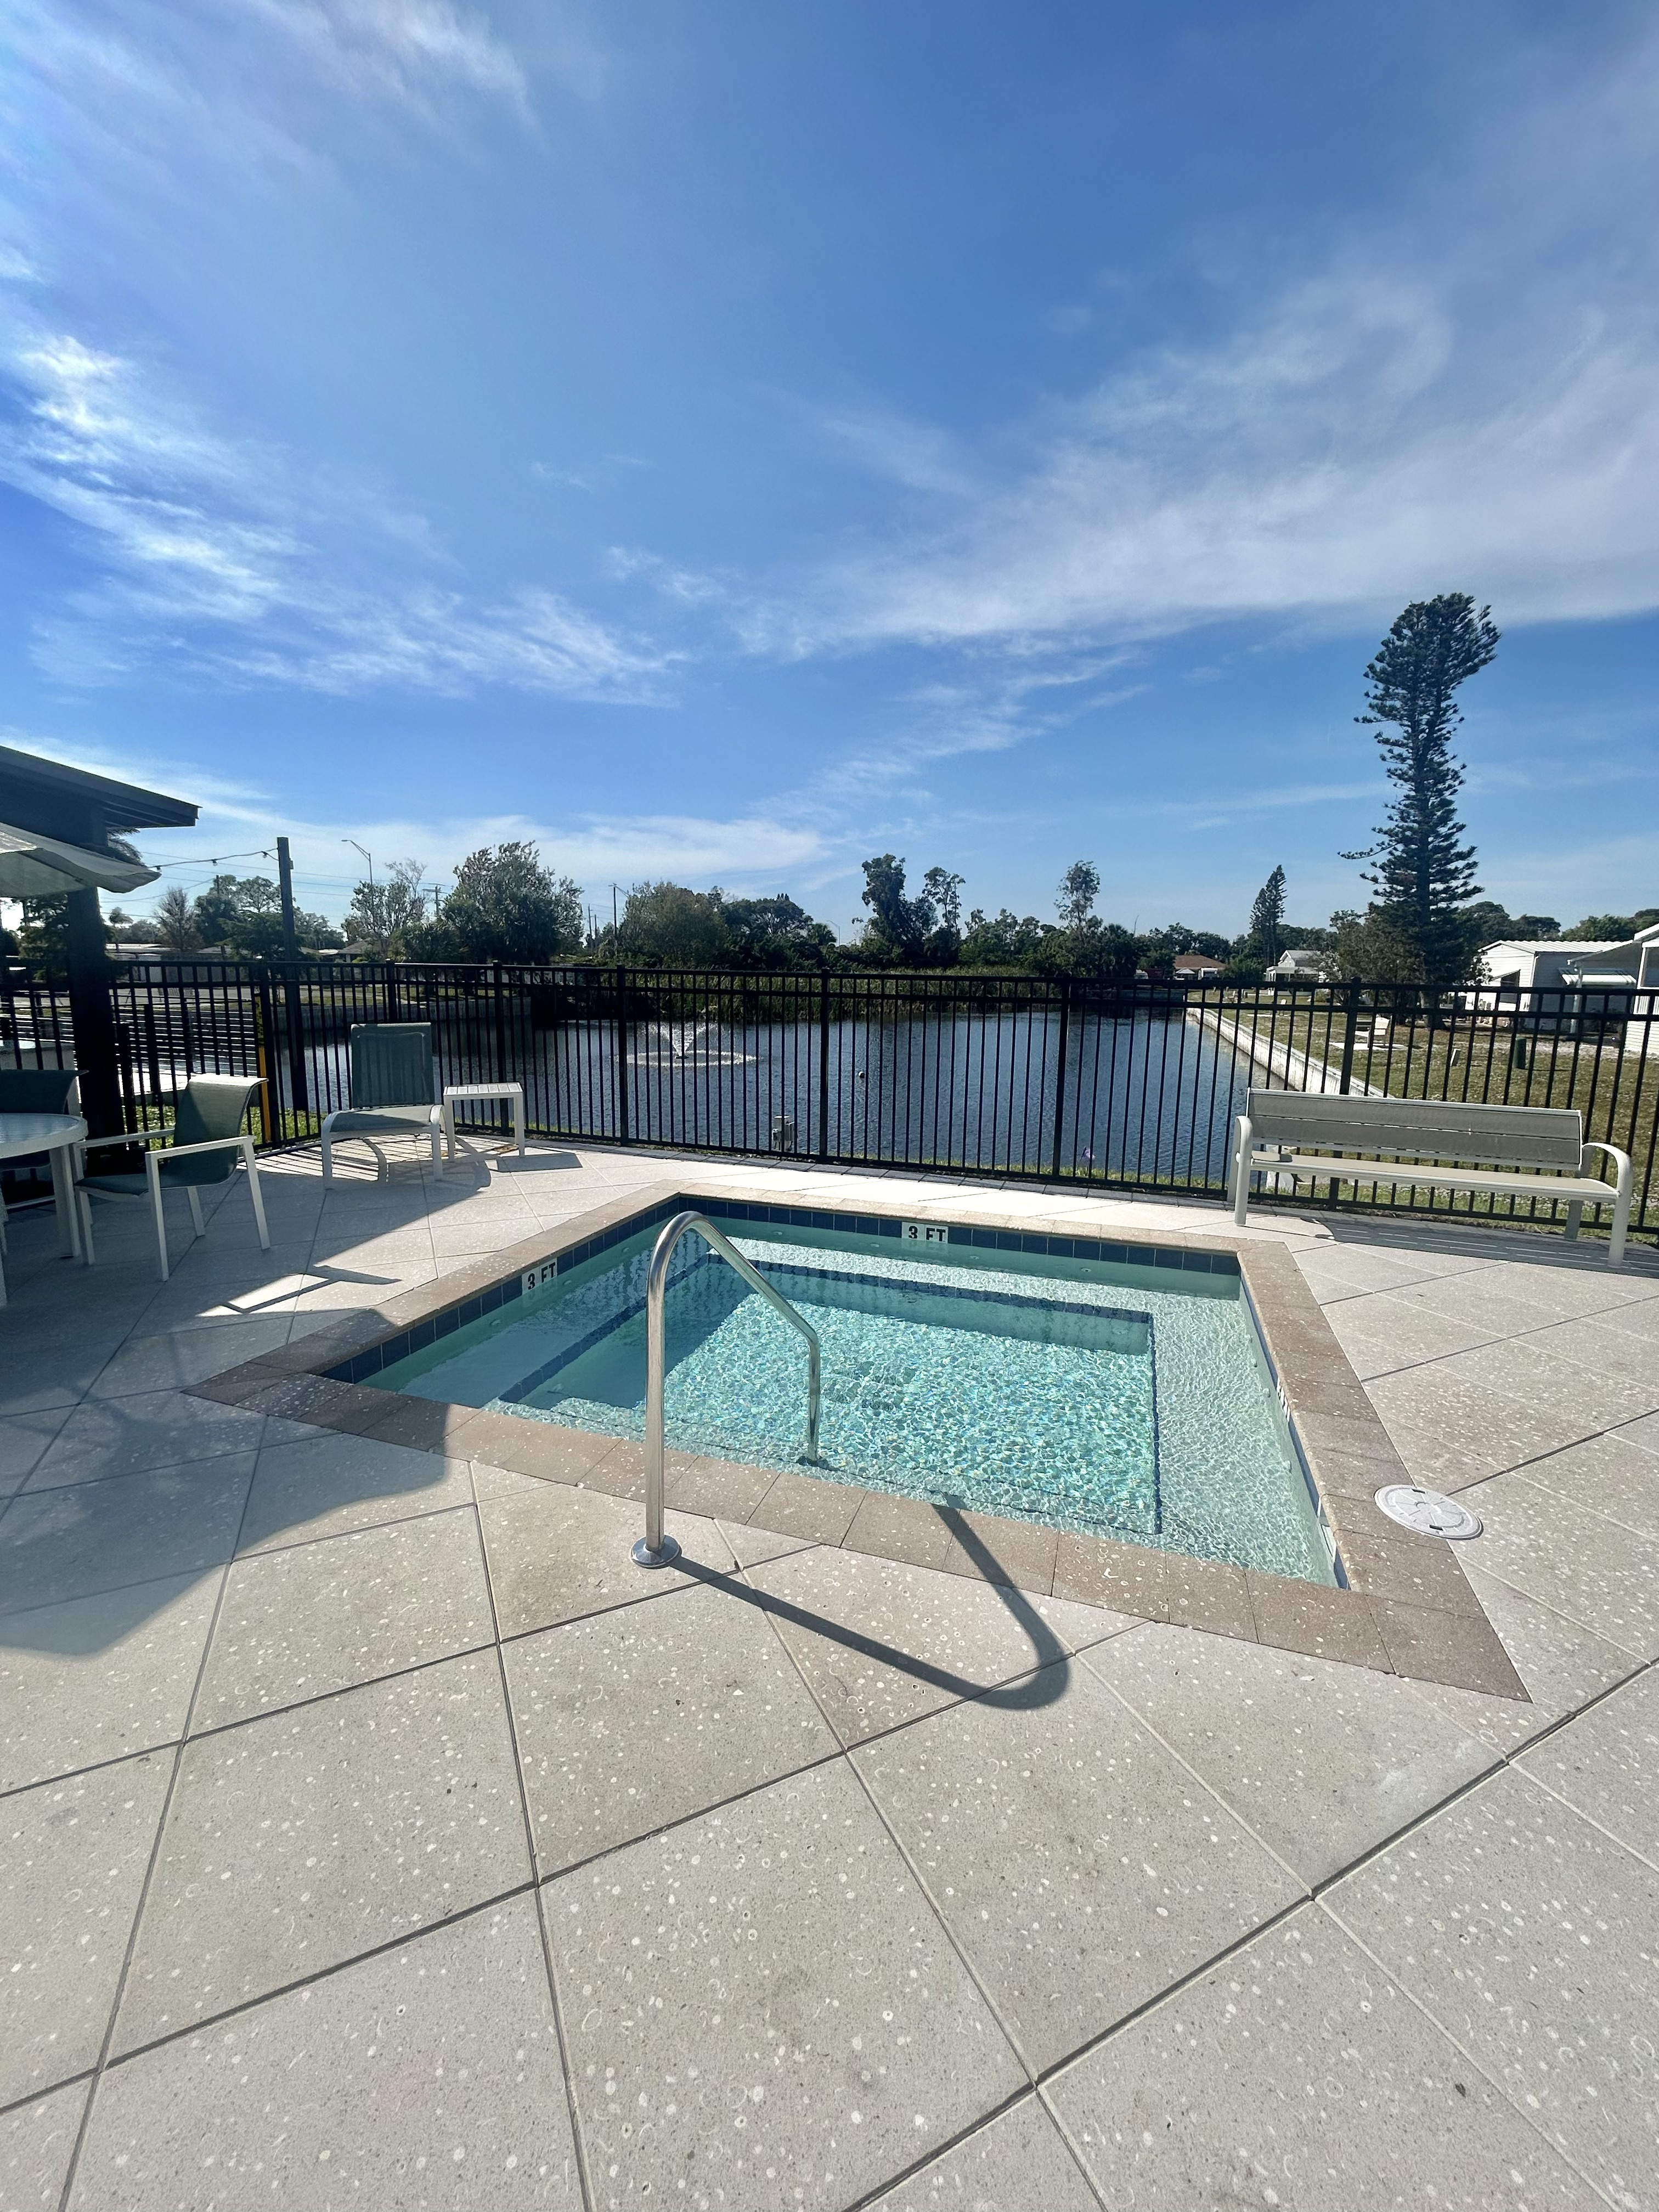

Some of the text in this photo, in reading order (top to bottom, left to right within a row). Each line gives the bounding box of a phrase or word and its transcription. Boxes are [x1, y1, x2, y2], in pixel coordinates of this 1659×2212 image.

[909, 1225, 946, 1242] 3 FT
[528, 1262, 556, 1290] 3 FT
